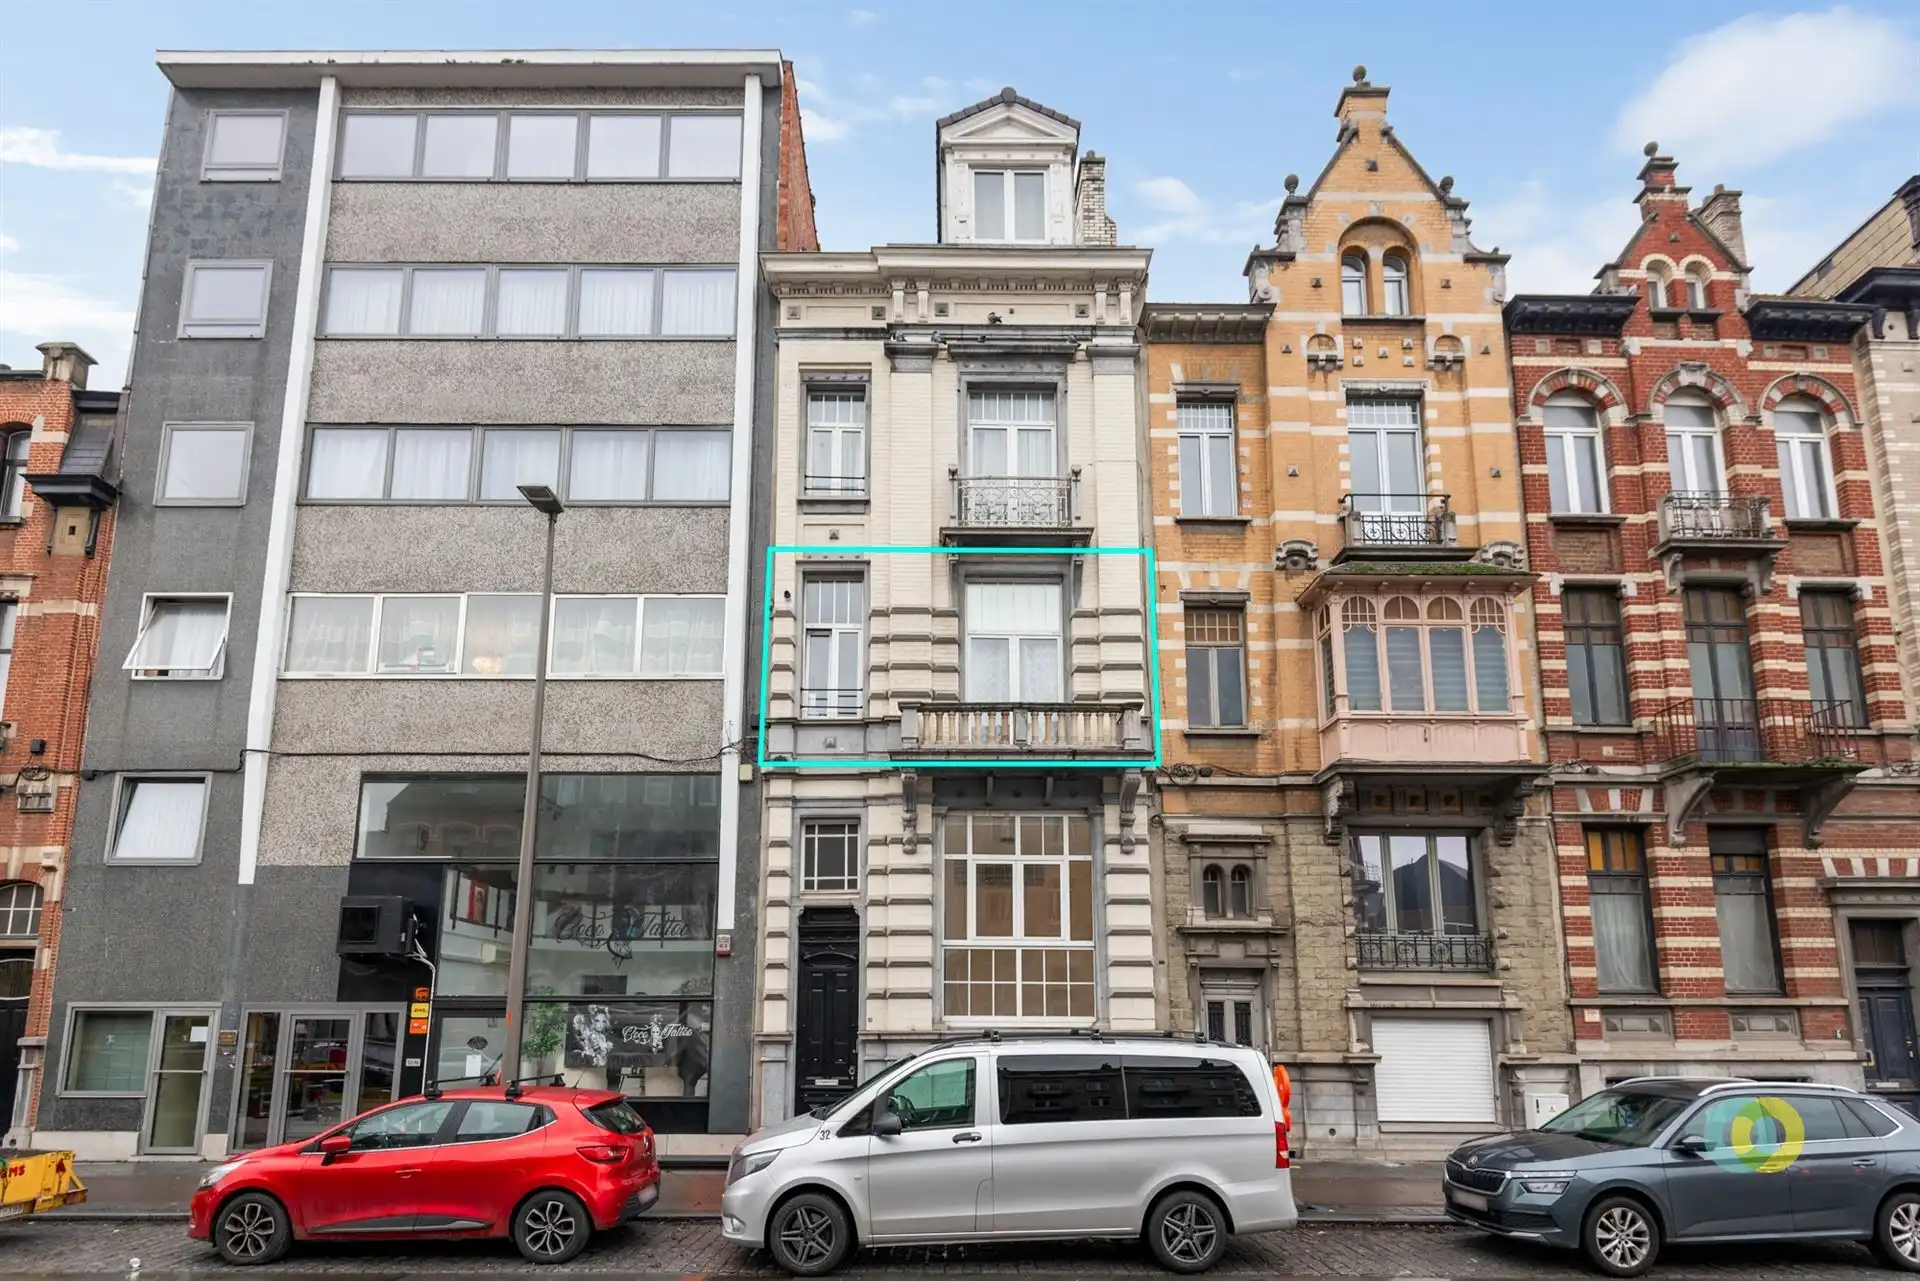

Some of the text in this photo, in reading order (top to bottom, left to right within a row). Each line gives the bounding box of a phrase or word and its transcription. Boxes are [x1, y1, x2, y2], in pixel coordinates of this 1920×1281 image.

[554, 911, 692, 943] Coco Tattoo
[622, 1023, 693, 1043] Coco Tattoo
[820, 1129, 831, 1141] 32
